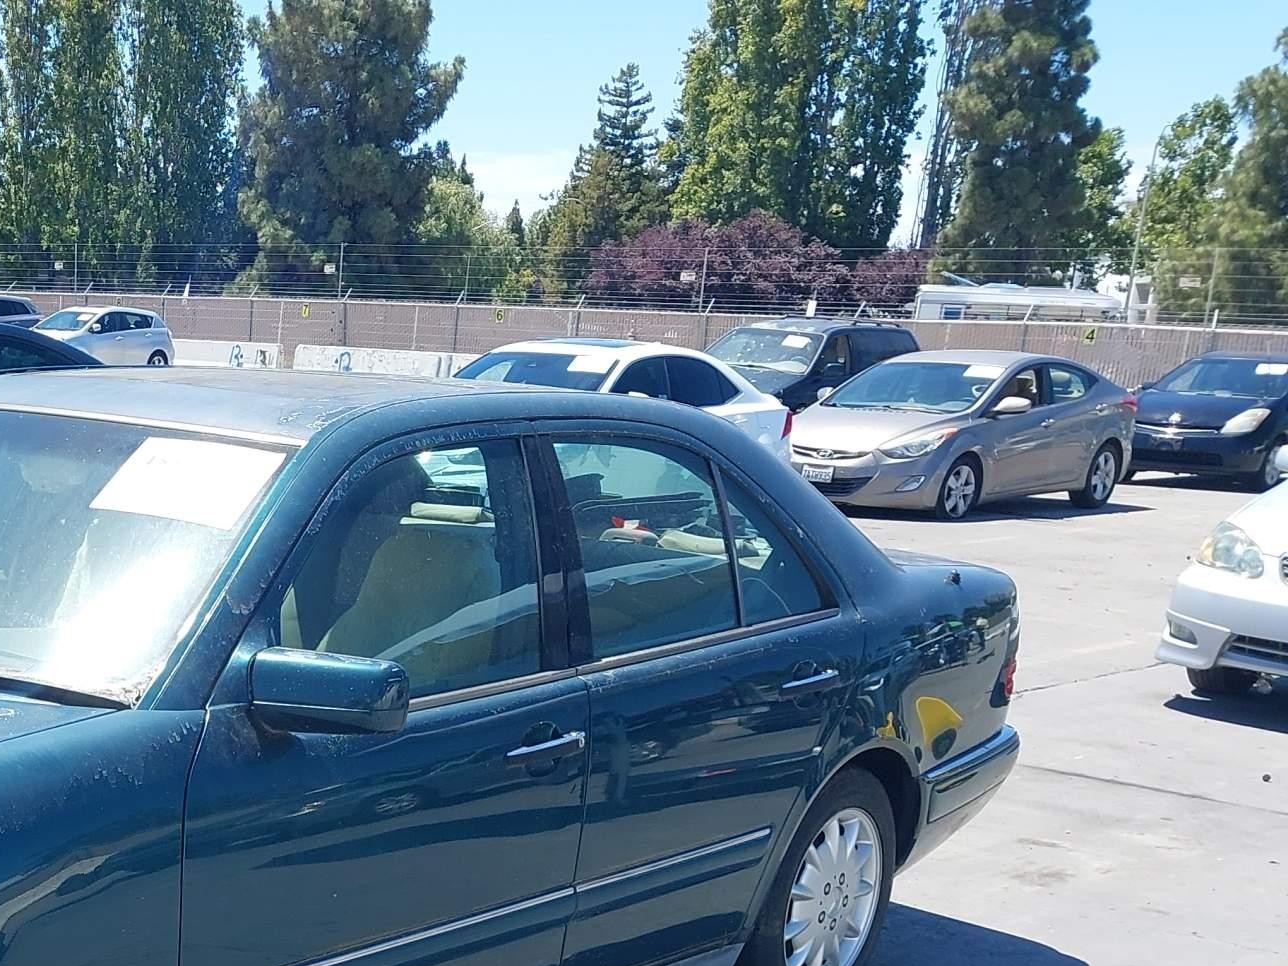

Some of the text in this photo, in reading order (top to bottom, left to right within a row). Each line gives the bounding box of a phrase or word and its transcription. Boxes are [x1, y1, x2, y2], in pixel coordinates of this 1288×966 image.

[303, 304, 309, 315] 7
[496, 309, 503, 321] 6
[1085, 328, 1096, 343] 4
